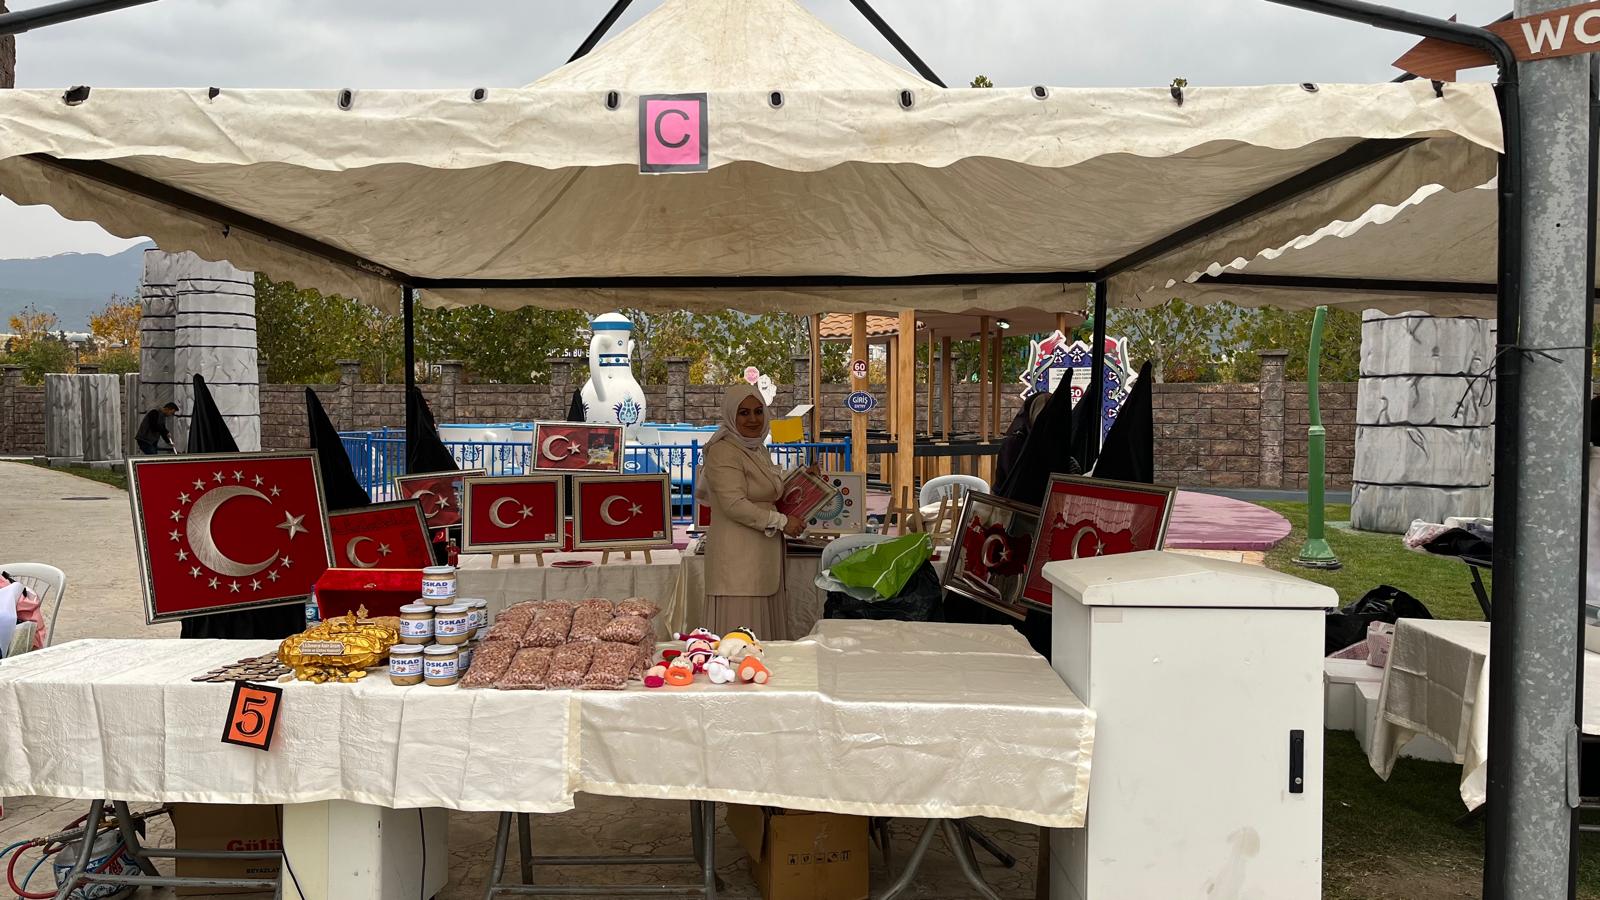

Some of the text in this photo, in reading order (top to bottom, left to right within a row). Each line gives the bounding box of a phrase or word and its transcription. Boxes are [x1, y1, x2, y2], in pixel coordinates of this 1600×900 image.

[655, 109, 690, 148] C
[855, 363, 866, 371] 60
[438, 618, 466, 626] OSKAD
[235, 696, 268, 737] 5
